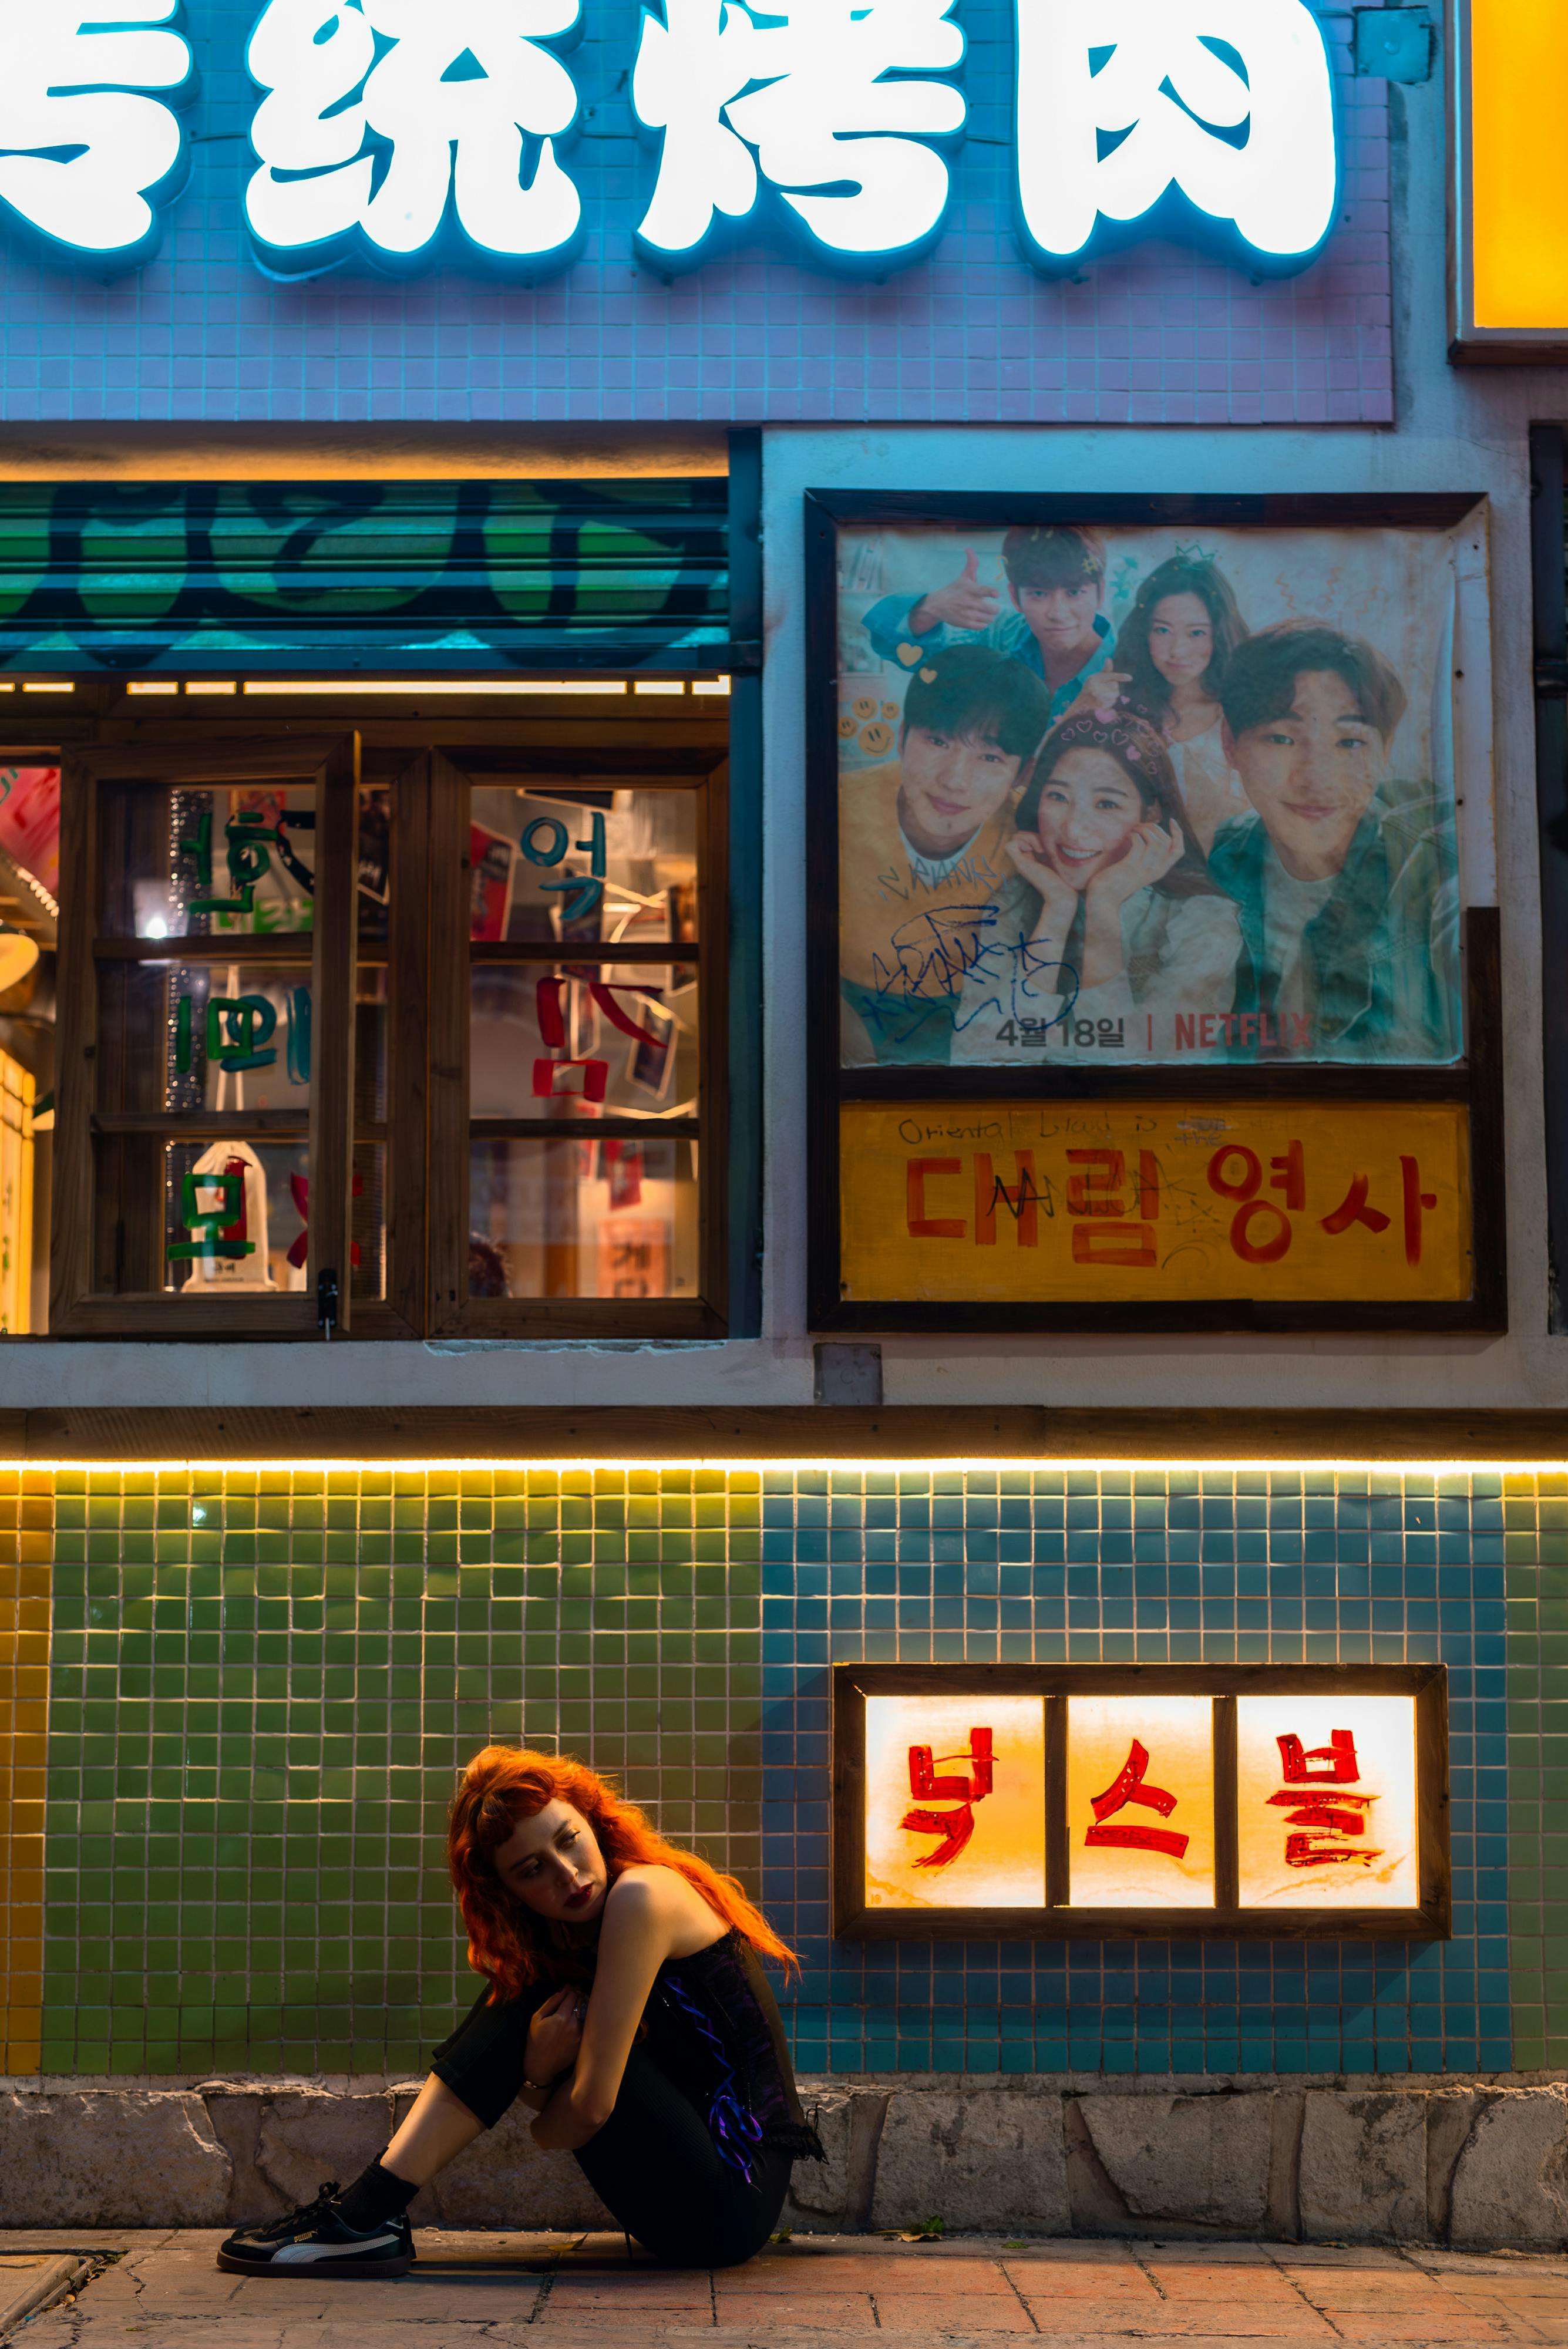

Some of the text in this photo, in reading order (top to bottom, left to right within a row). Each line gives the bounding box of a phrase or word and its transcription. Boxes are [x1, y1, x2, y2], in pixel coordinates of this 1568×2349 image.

[996, 1018, 1125, 1048] 4월 18일
[1175, 1013, 1314, 1051] NETFLIX
